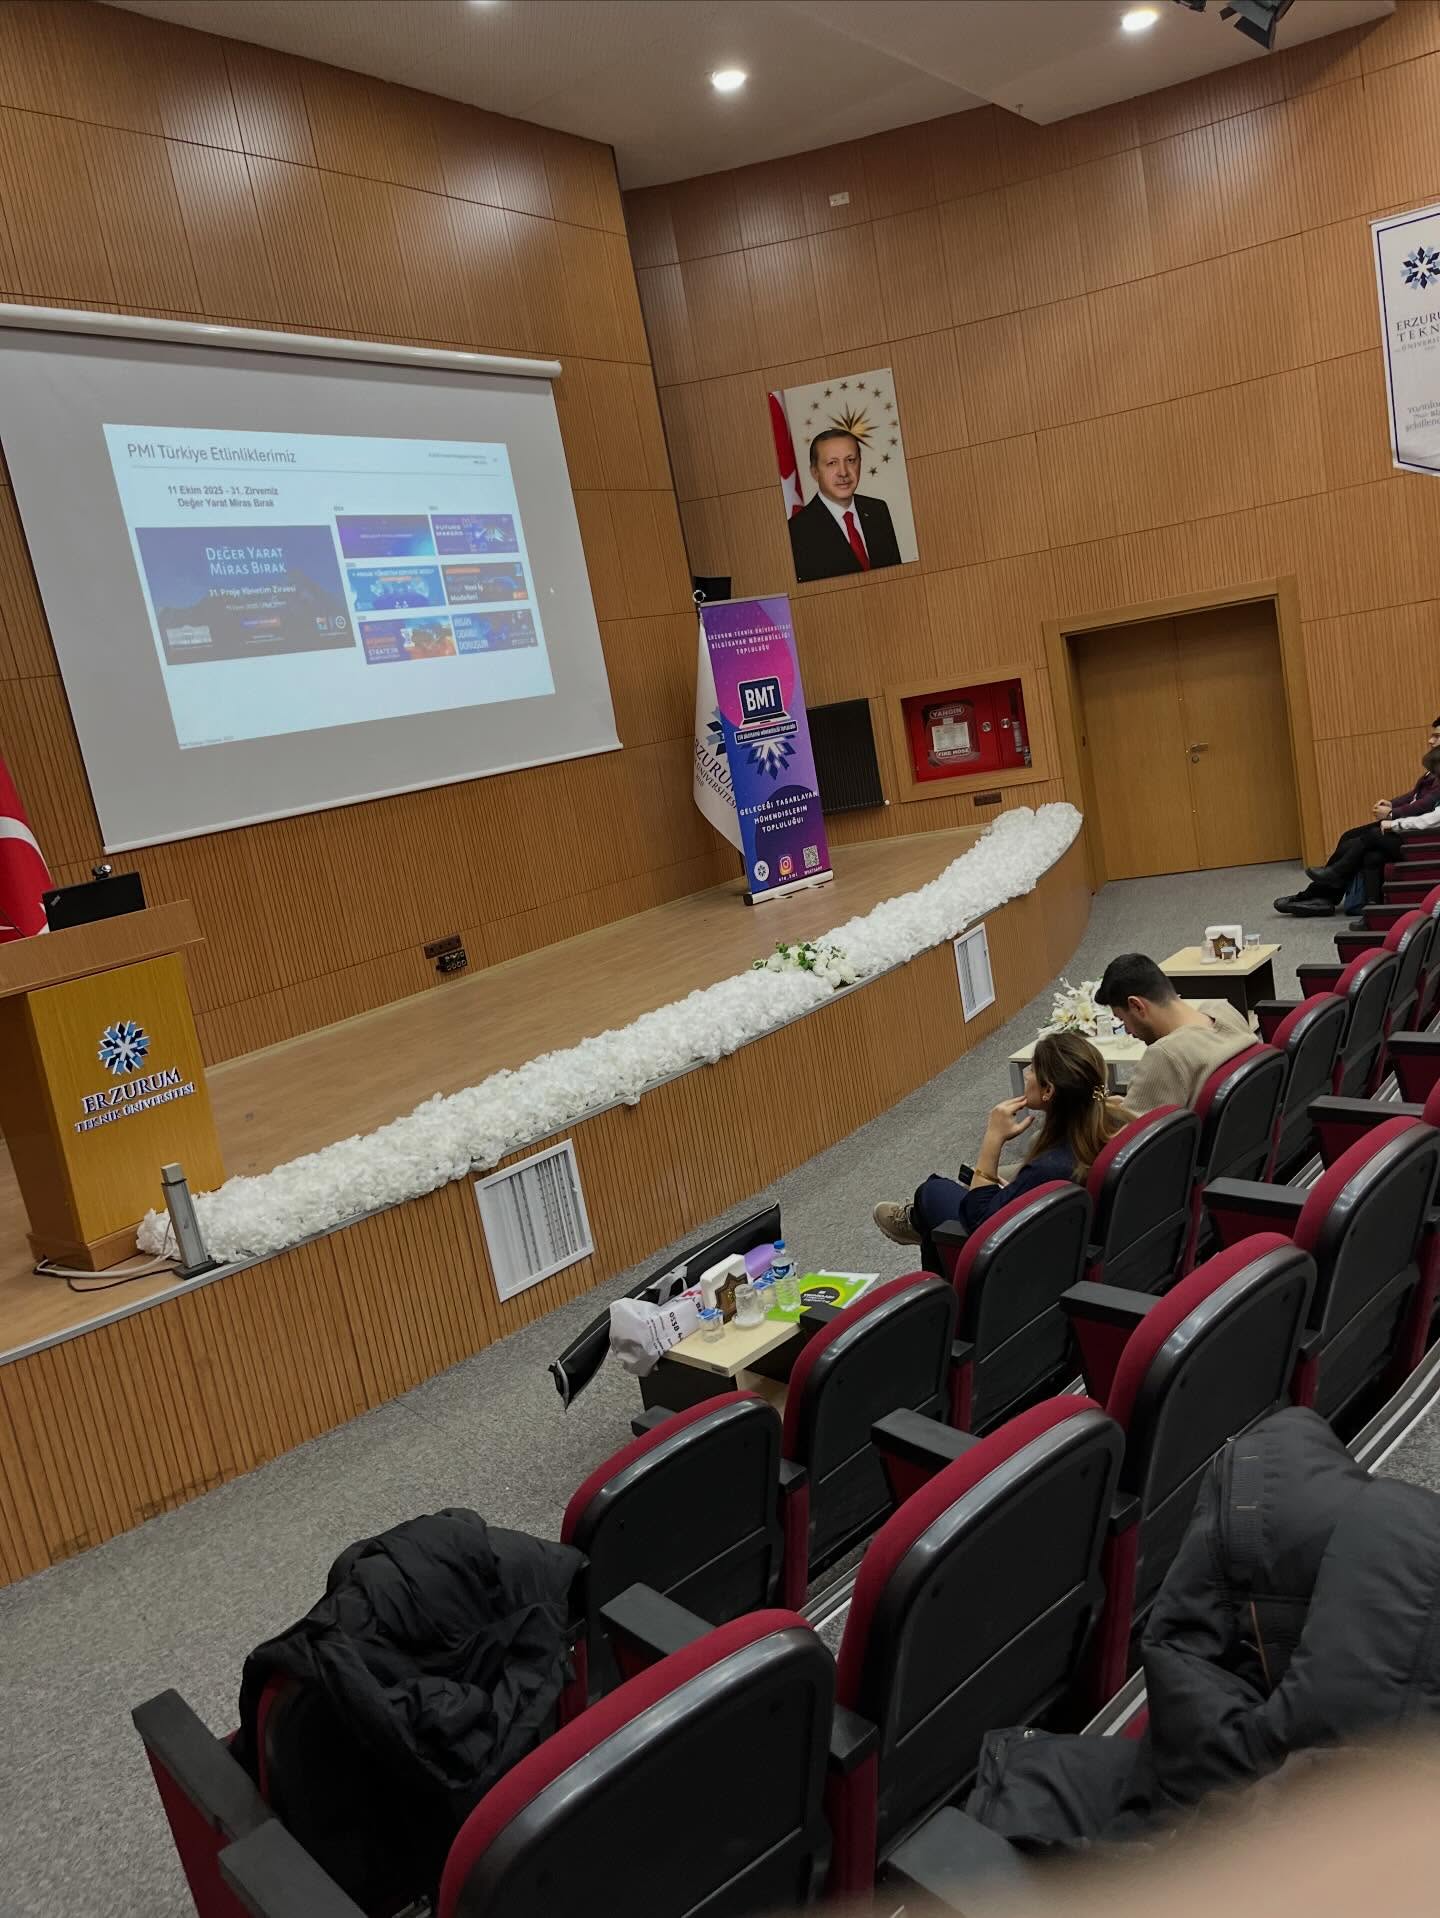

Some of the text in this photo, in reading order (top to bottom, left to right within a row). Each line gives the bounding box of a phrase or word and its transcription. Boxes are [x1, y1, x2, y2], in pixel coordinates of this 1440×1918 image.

[127, 443, 155, 459] PMI
[157, 444, 208, 463] Türkiye
[179, 485, 201, 495] Ekim
[204, 486, 224, 495] 2025
[245, 486, 279, 496] Zirvemiz
[177, 498, 204, 510] Değer
[205, 498, 228, 508] Yarat
[230, 499, 252, 508] Miras
[205, 546, 283, 561] DEĞER YARAT
[210, 561, 287, 576] MİRAS BIRAK
[744, 685, 775, 712] BMT
[82, 1066, 183, 1115] ERZURUM
